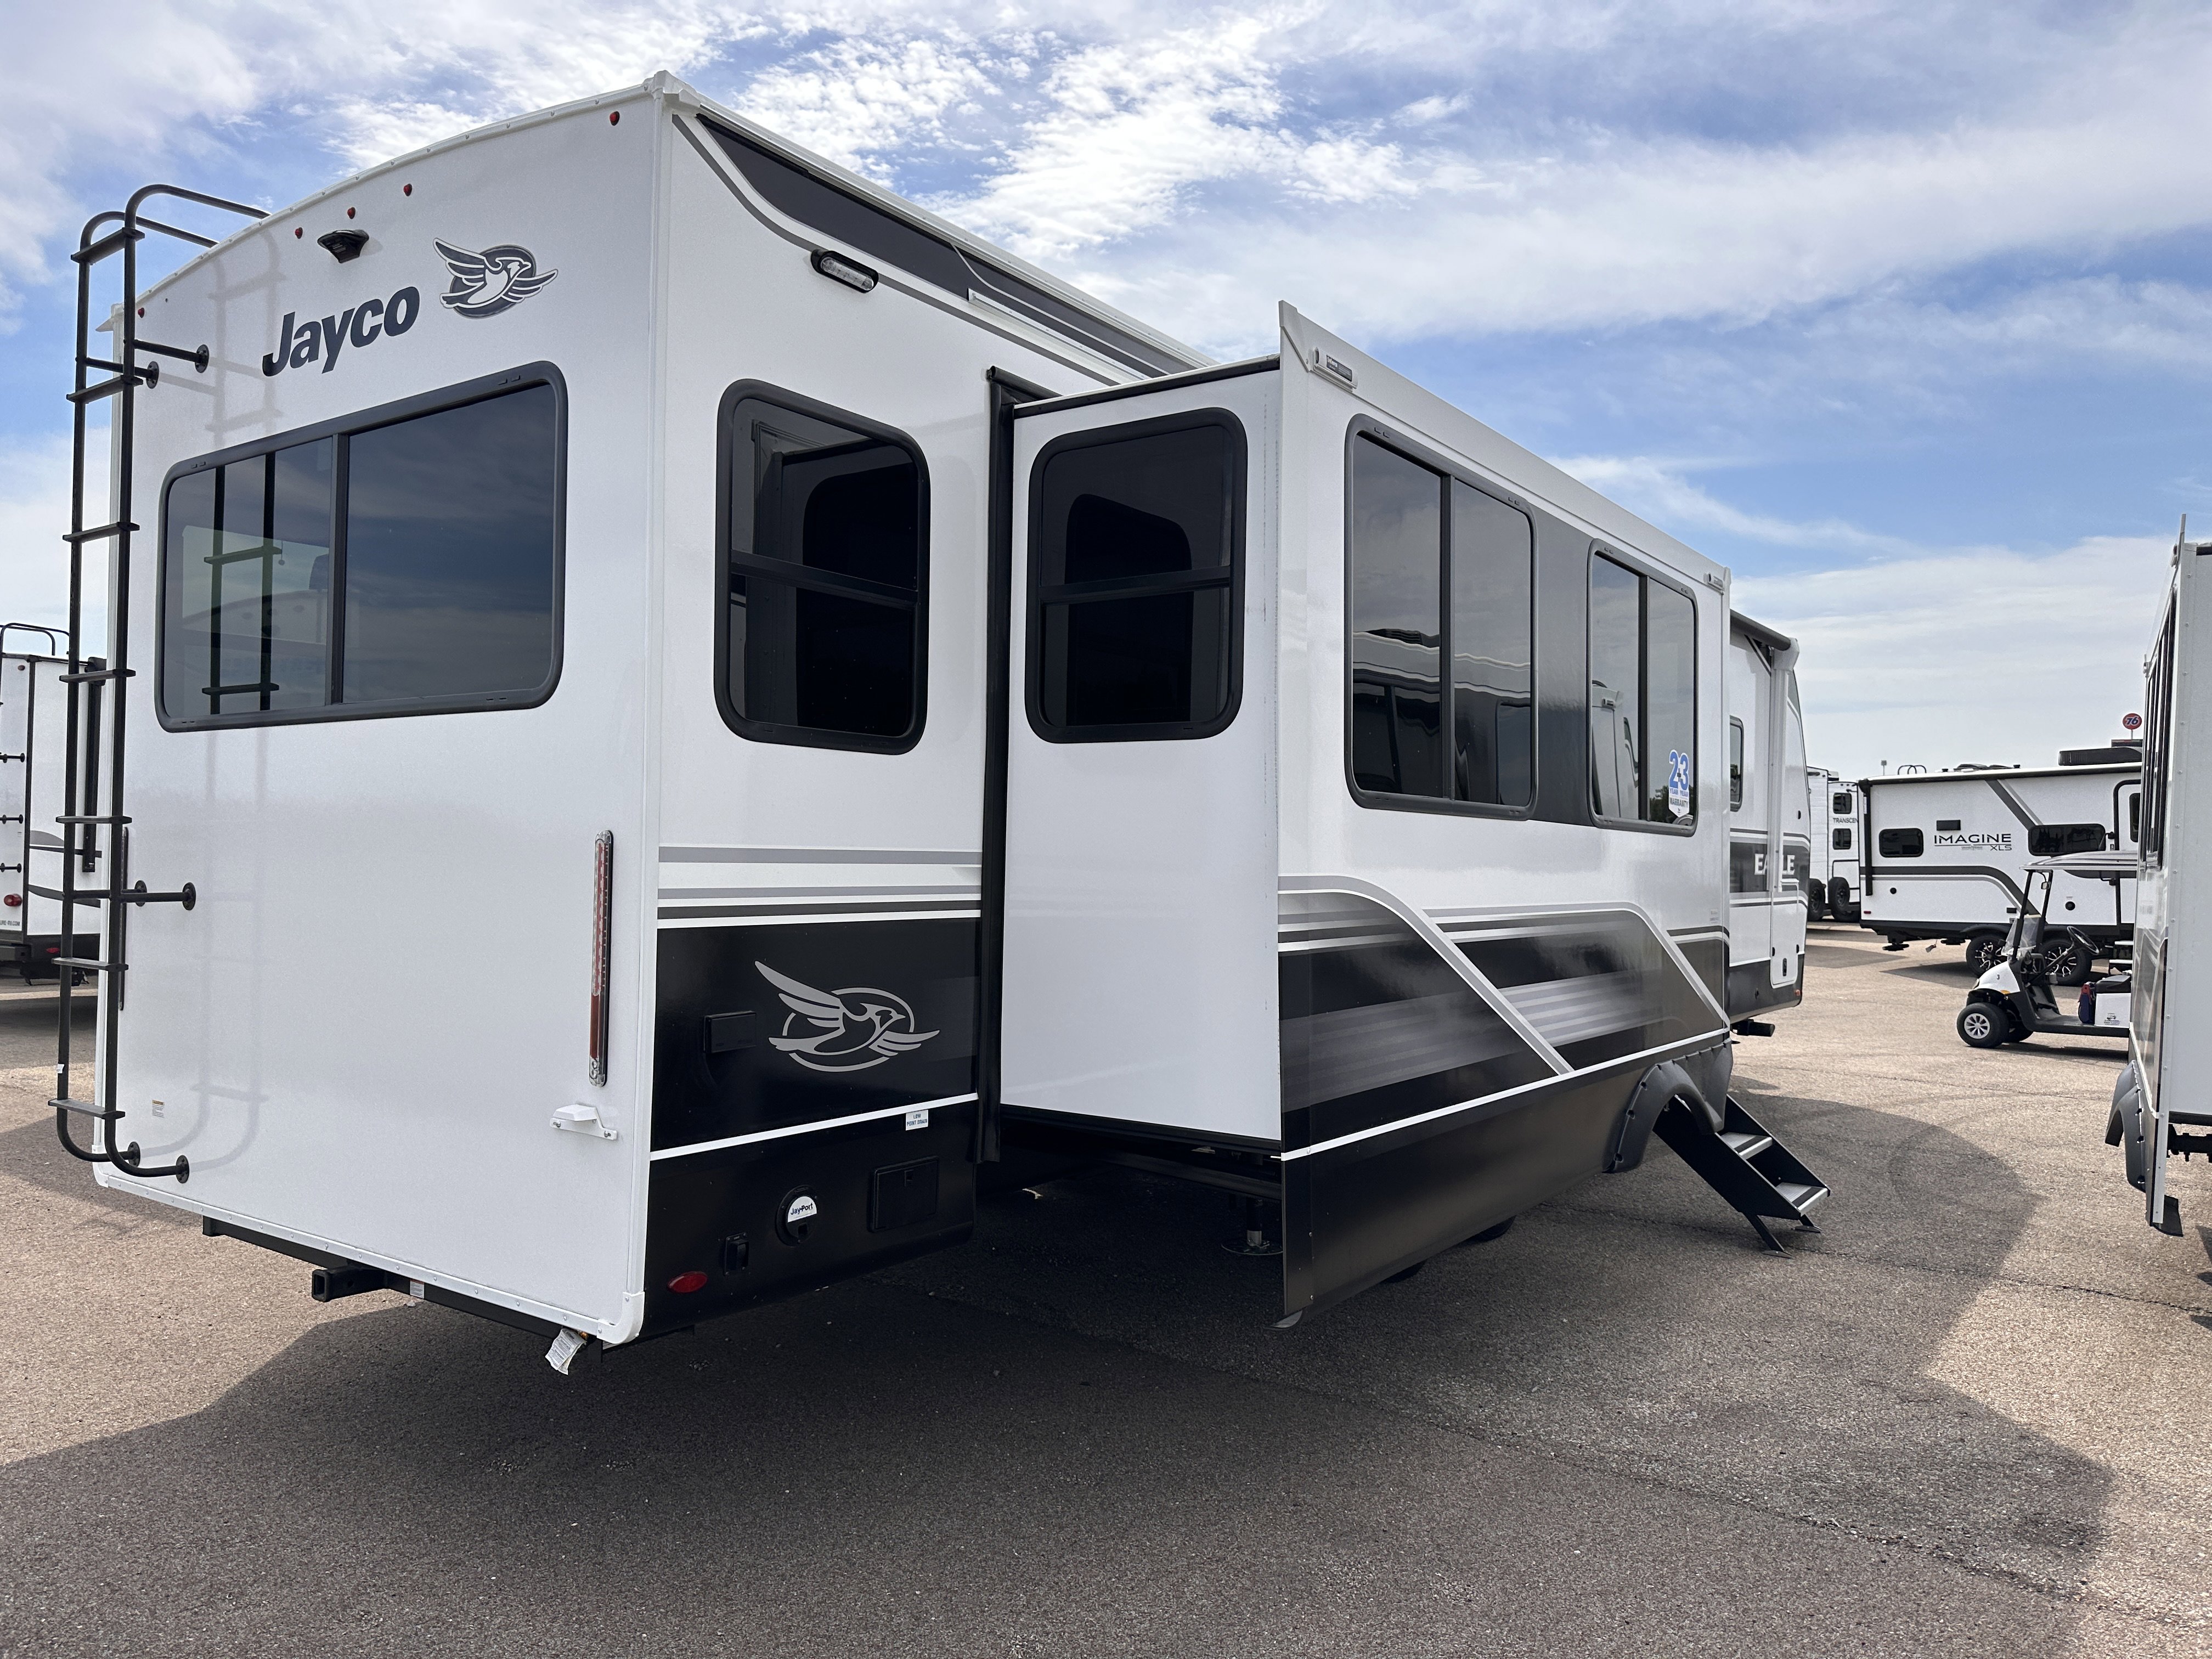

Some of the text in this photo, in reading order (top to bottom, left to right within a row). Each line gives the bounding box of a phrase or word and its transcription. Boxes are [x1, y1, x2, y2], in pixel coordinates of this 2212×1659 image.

[262, 286, 420, 377] Jayco
[2126, 716, 2139, 725] 76
[1934, 833, 2012, 844] IMAGINE
